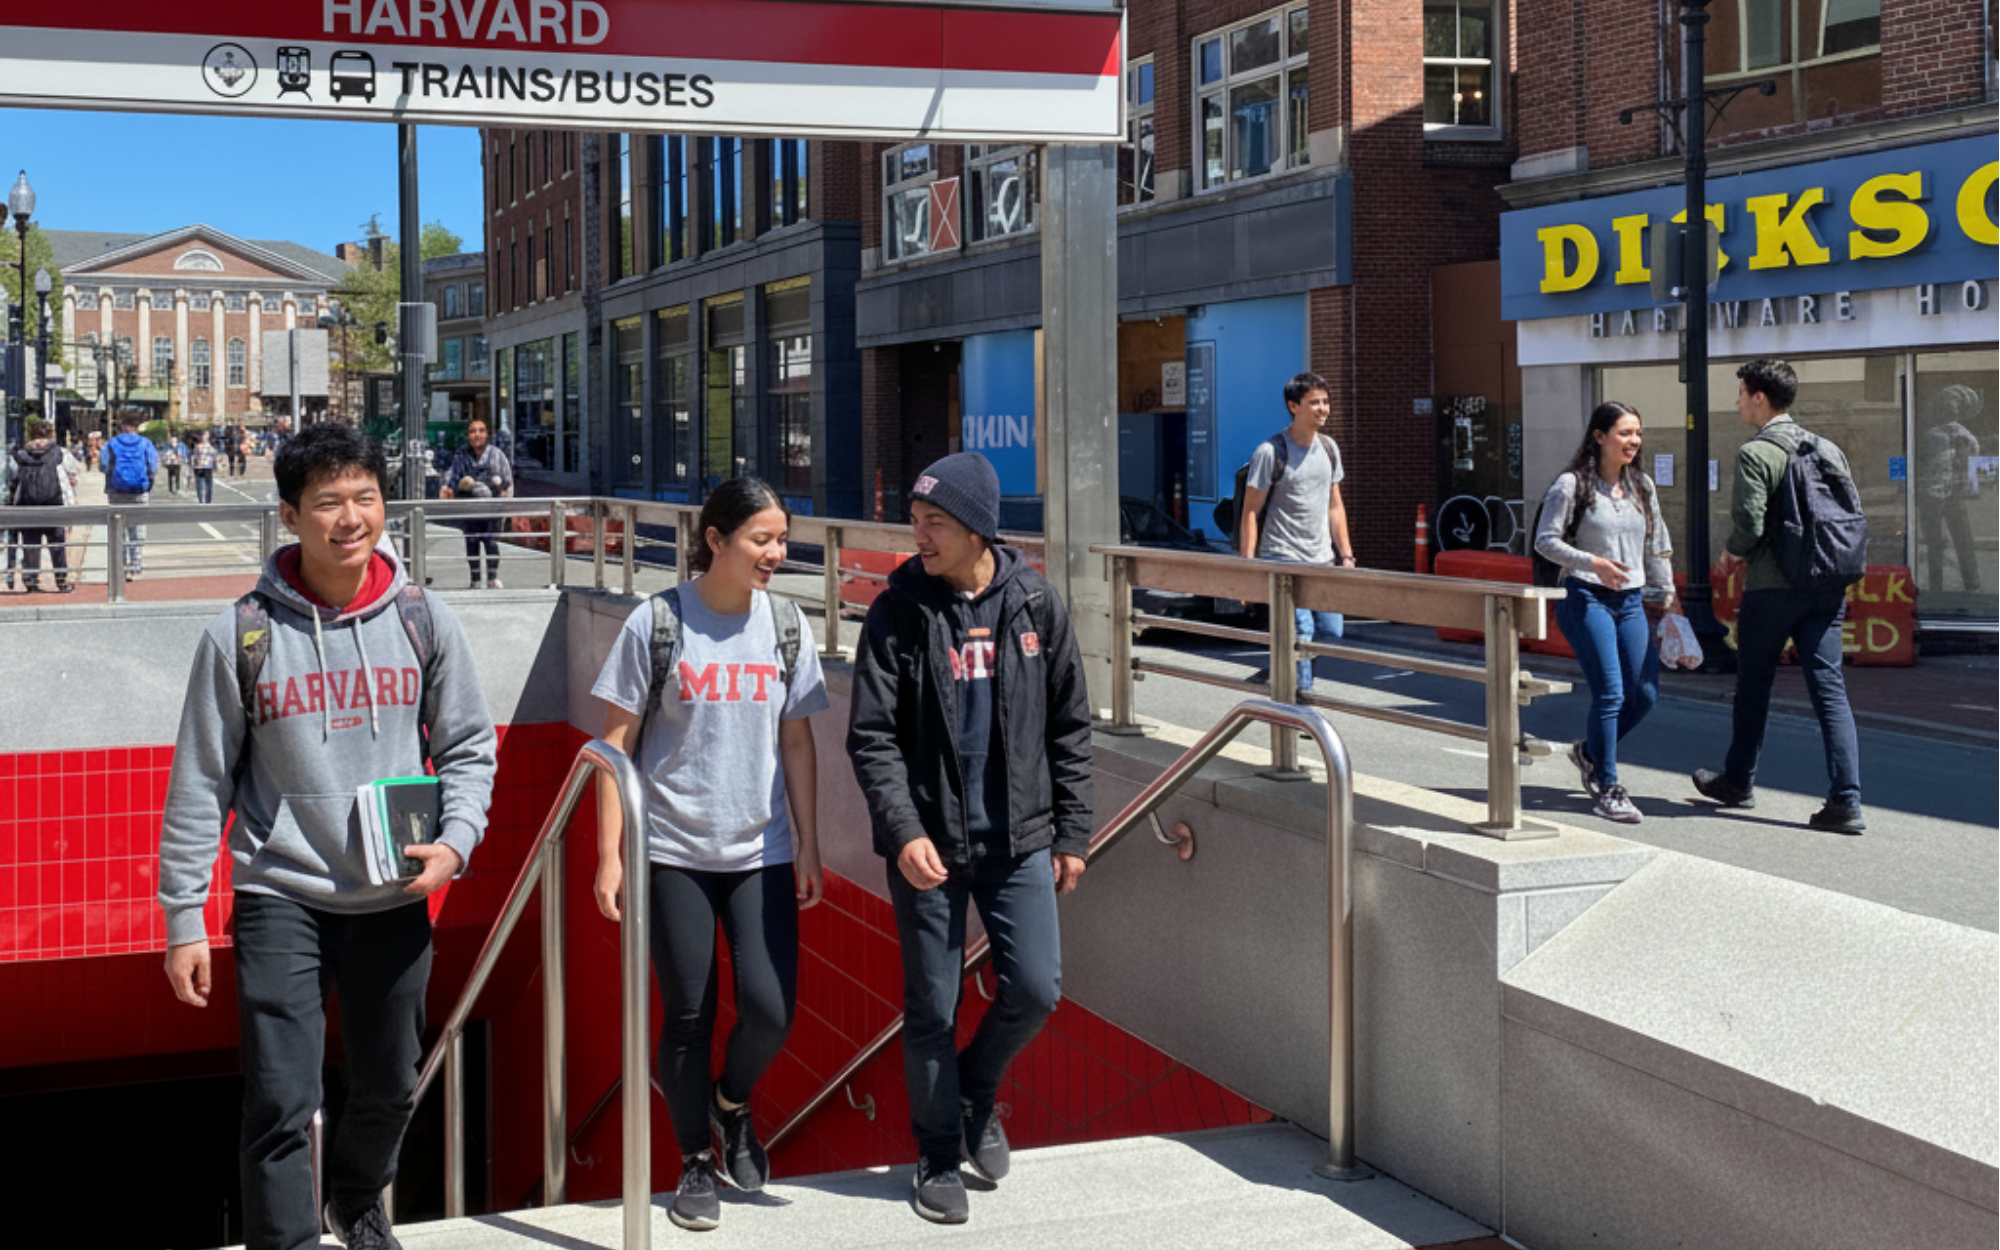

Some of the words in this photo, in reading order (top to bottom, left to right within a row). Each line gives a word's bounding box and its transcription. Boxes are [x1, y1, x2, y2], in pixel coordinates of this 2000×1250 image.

[322, 0, 610, 45] HARVARD
[392, 62, 714, 108] TRAINS/BUSES
[1537, 160, 1999, 294] DIKSO
[1590, 290, 1851, 338] HARWARE
[257, 667, 419, 725] HARVARD
[678, 661, 777, 701] MIT
